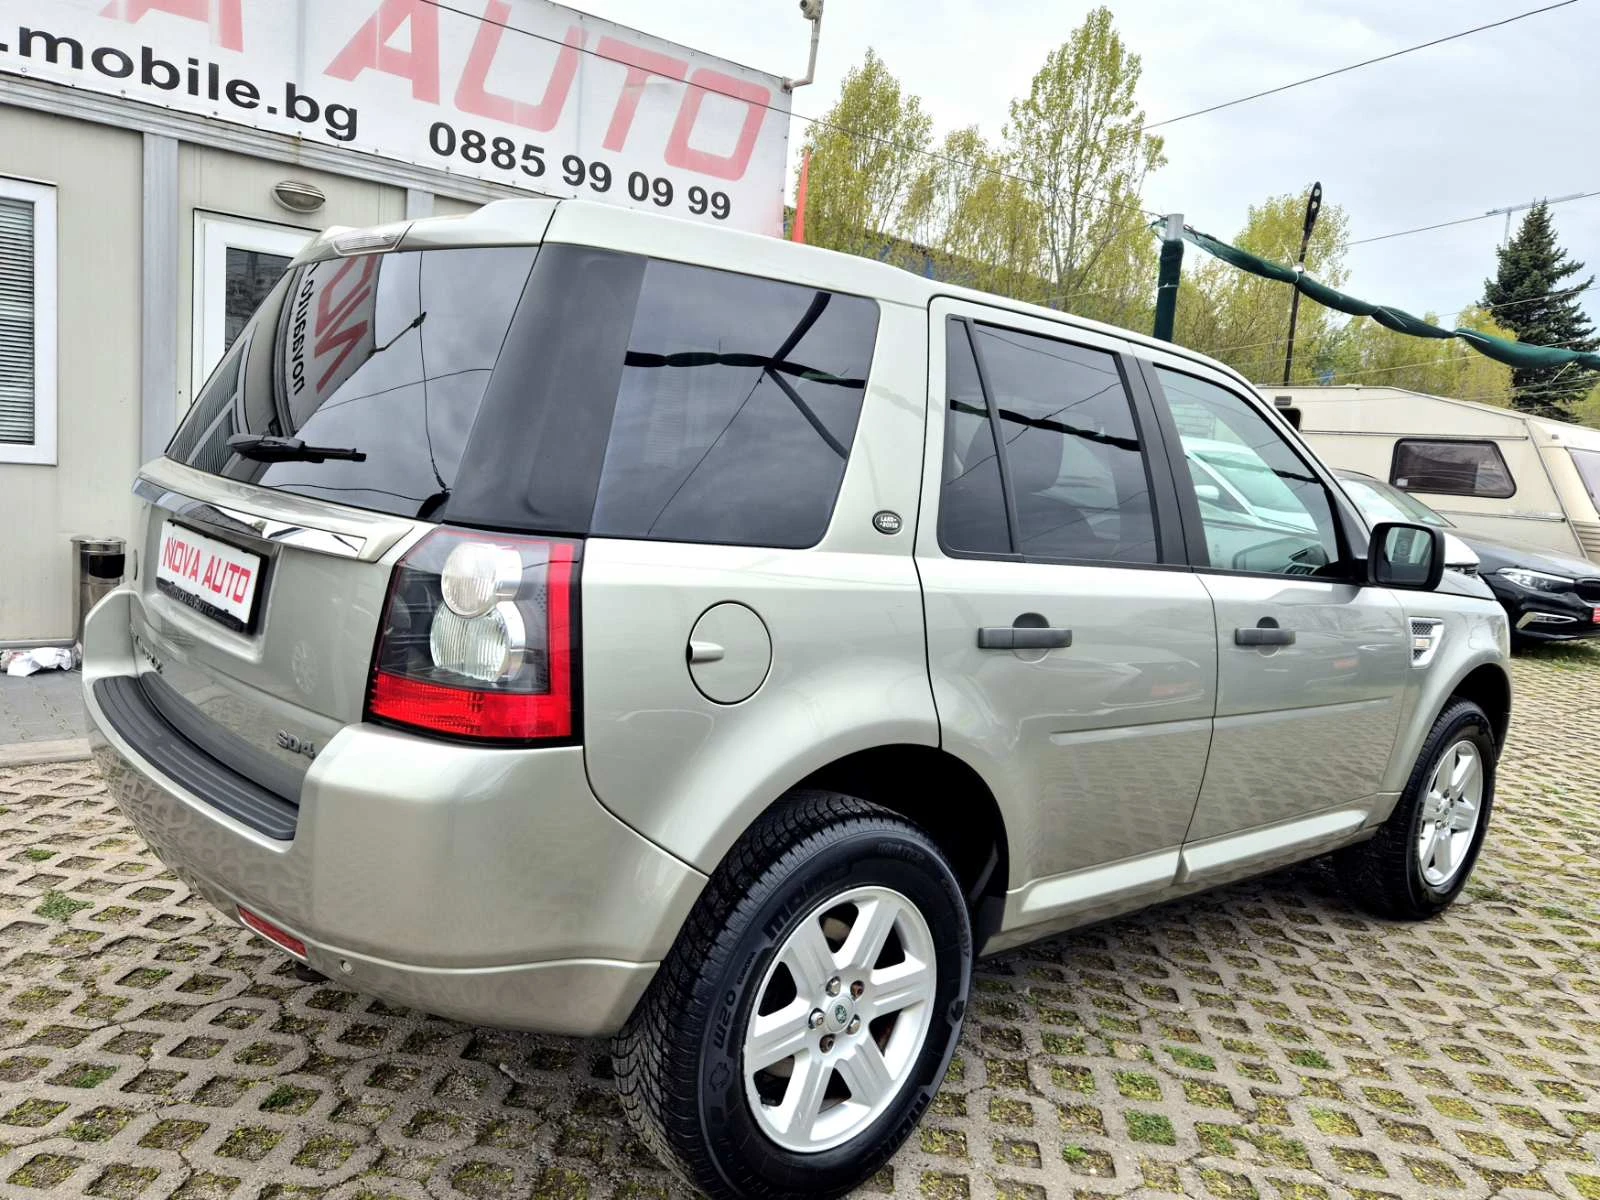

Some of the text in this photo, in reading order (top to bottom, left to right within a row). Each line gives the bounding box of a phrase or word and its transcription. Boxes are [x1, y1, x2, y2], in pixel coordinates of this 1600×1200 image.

[322, 0, 772, 182] AUTO
[428, 121, 731, 220] 0885 99 09 99
[163, 536, 252, 605] NOVA AUTO
